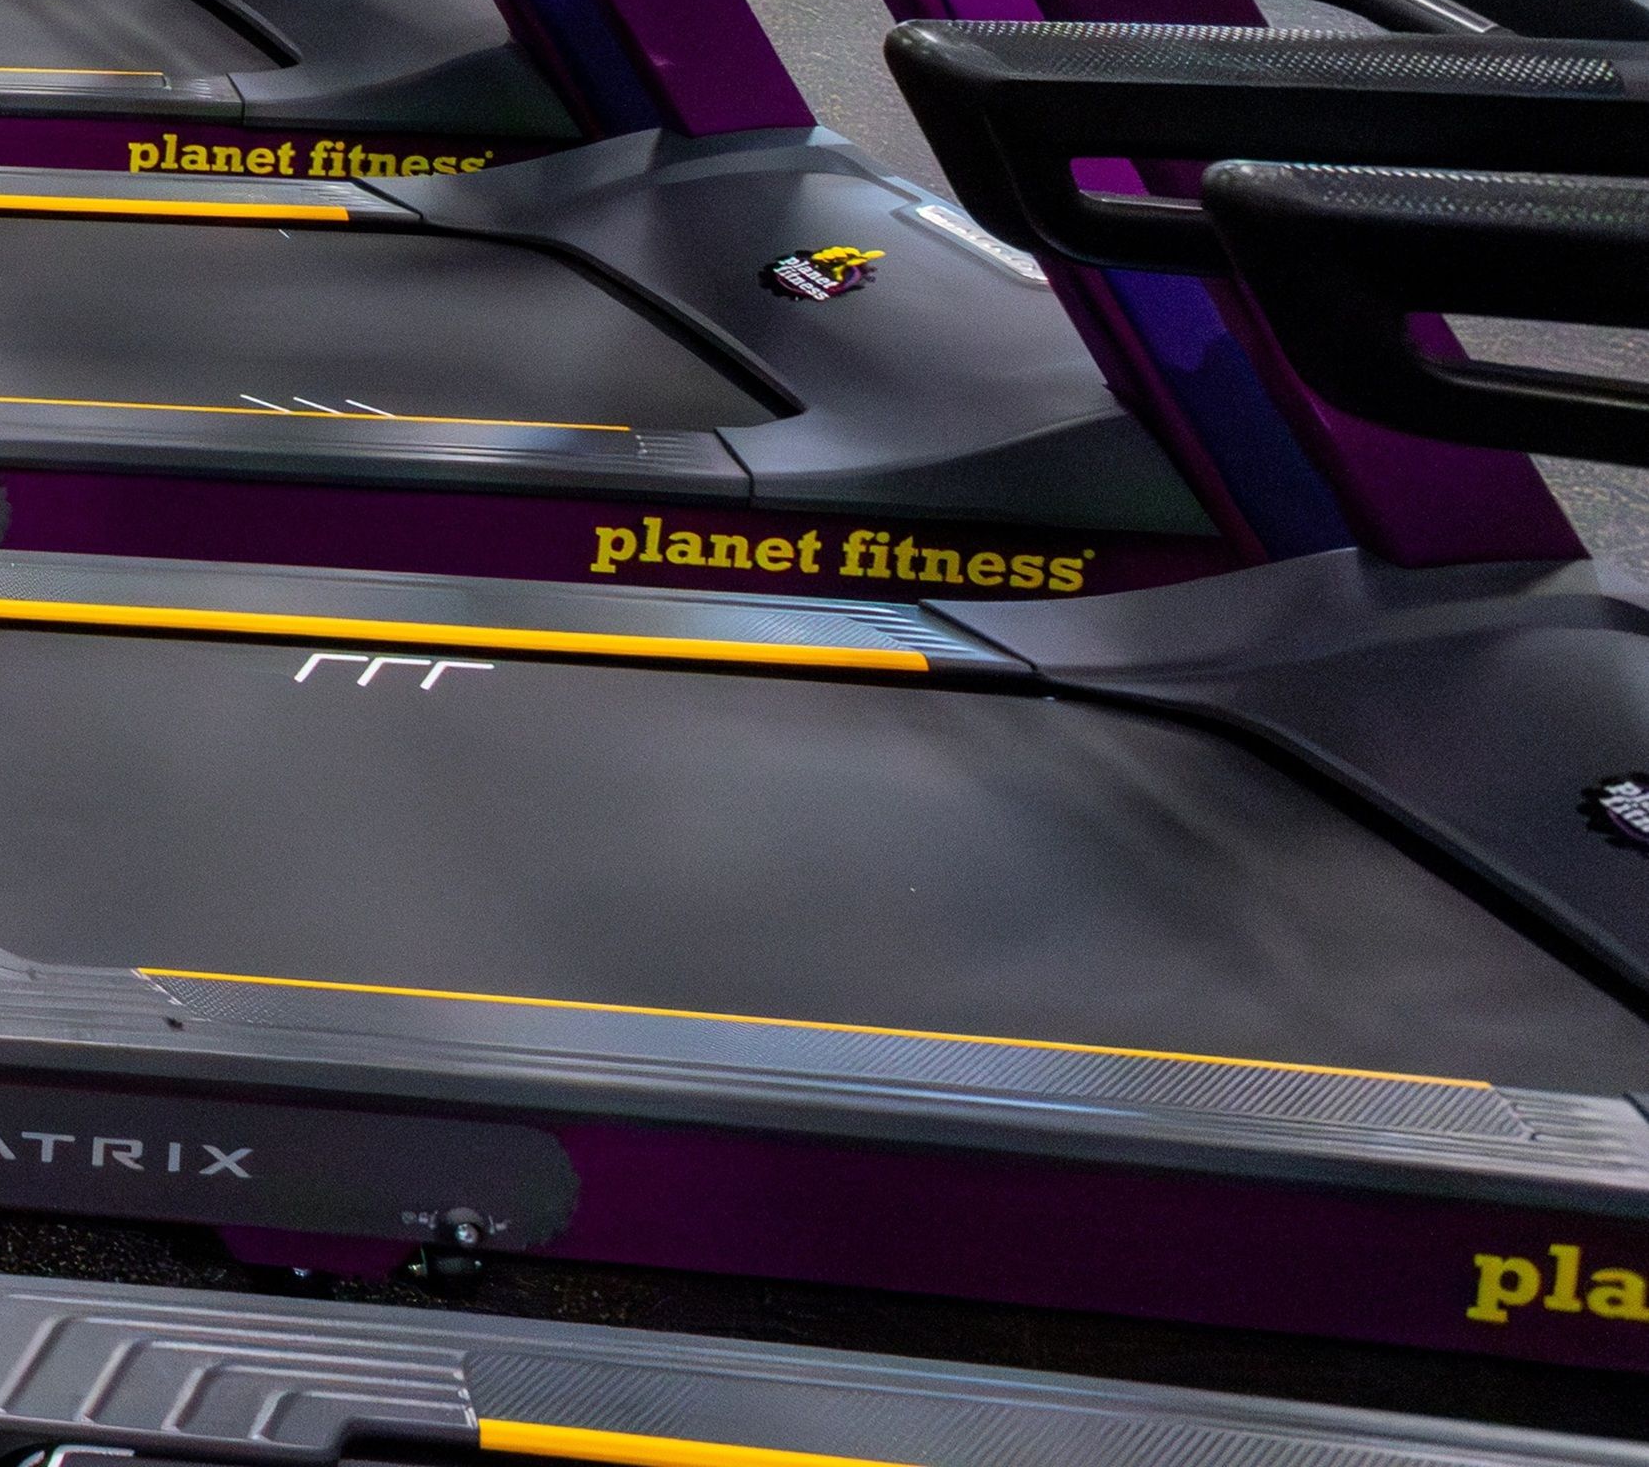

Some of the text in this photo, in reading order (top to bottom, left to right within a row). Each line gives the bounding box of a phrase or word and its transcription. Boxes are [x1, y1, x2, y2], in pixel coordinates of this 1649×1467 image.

[127, 133, 297, 176] planet
[773, 265, 830, 301] fitness
[778, 256, 840, 288] planet
[590, 516, 1086, 593] planet fitness
[1465, 1244, 1649, 1324] pla
